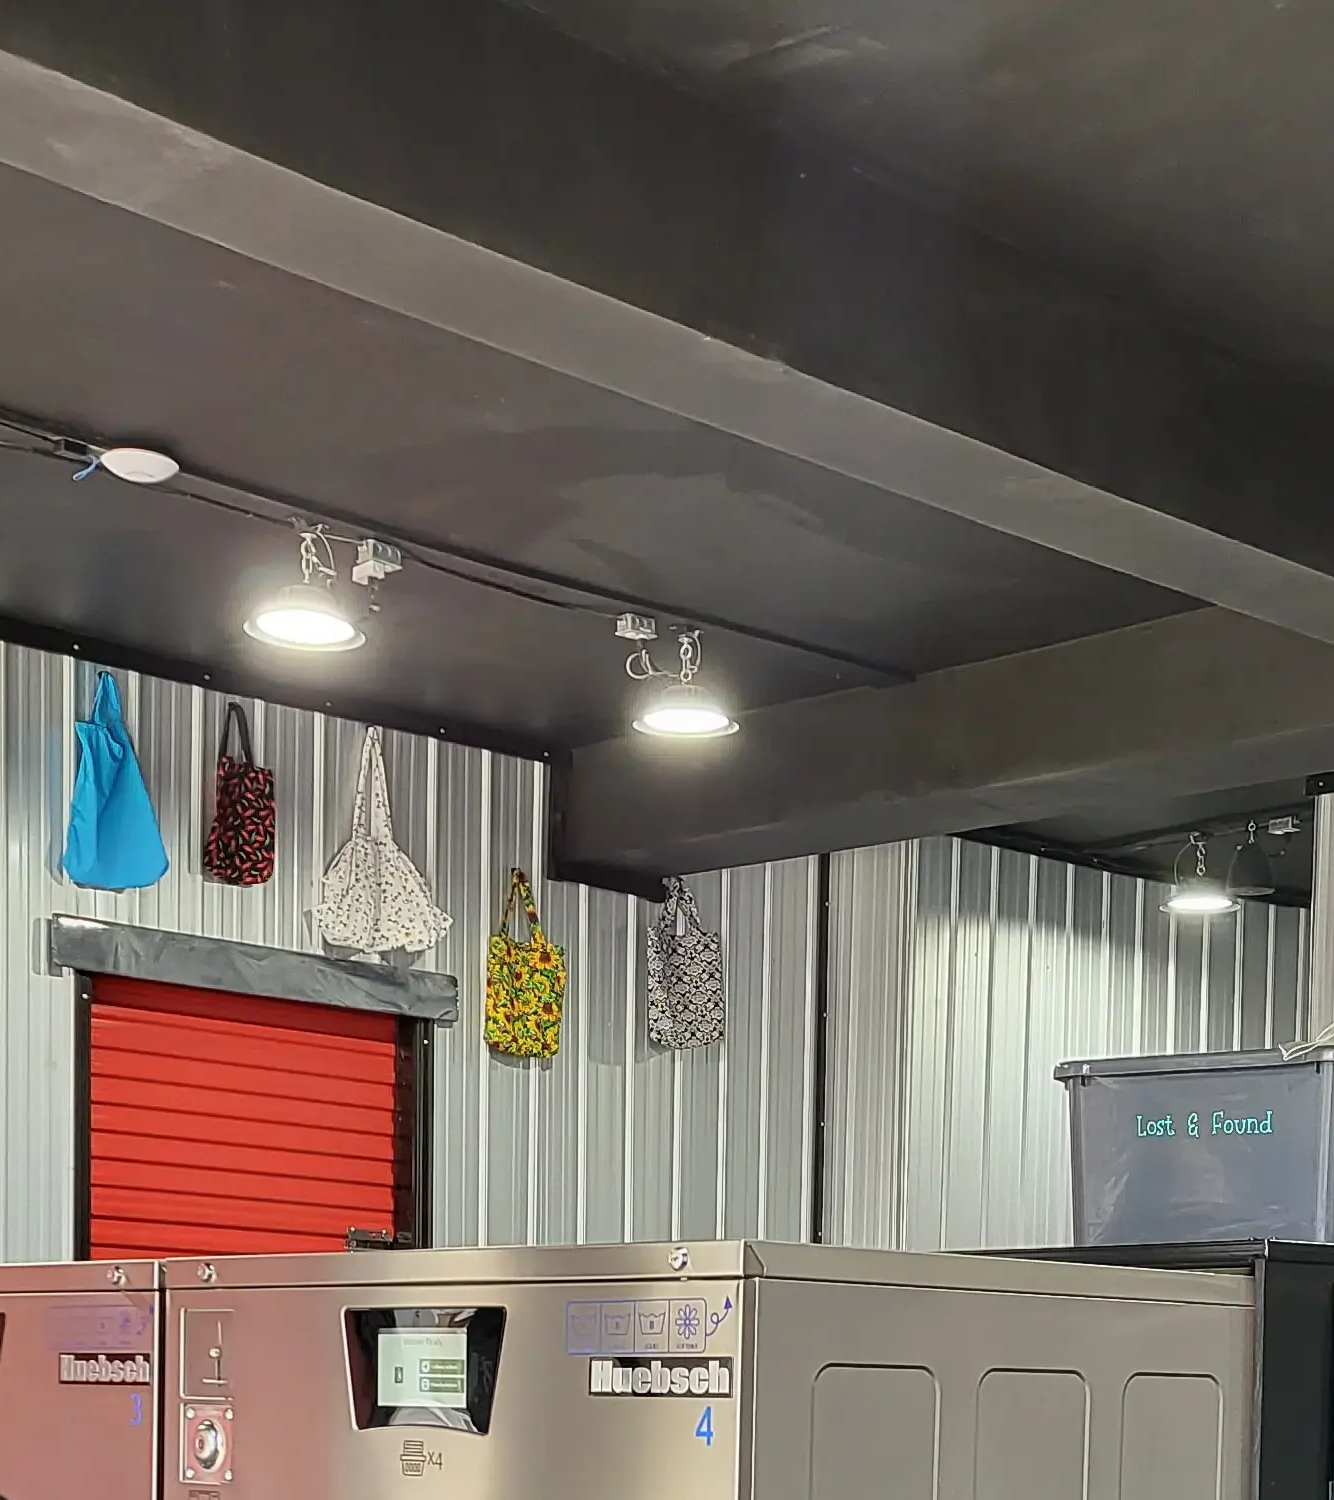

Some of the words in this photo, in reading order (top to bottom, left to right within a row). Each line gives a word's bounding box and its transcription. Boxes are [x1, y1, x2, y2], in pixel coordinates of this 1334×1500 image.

[1136, 1115, 1175, 1137] Lost
[1187, 1112, 1199, 1138] &
[59, 1354, 150, 1383] Huebsch
[590, 1359, 730, 1395] Huebsch
[129, 1393, 143, 1426] 3
[695, 1405, 714, 1447] 4
